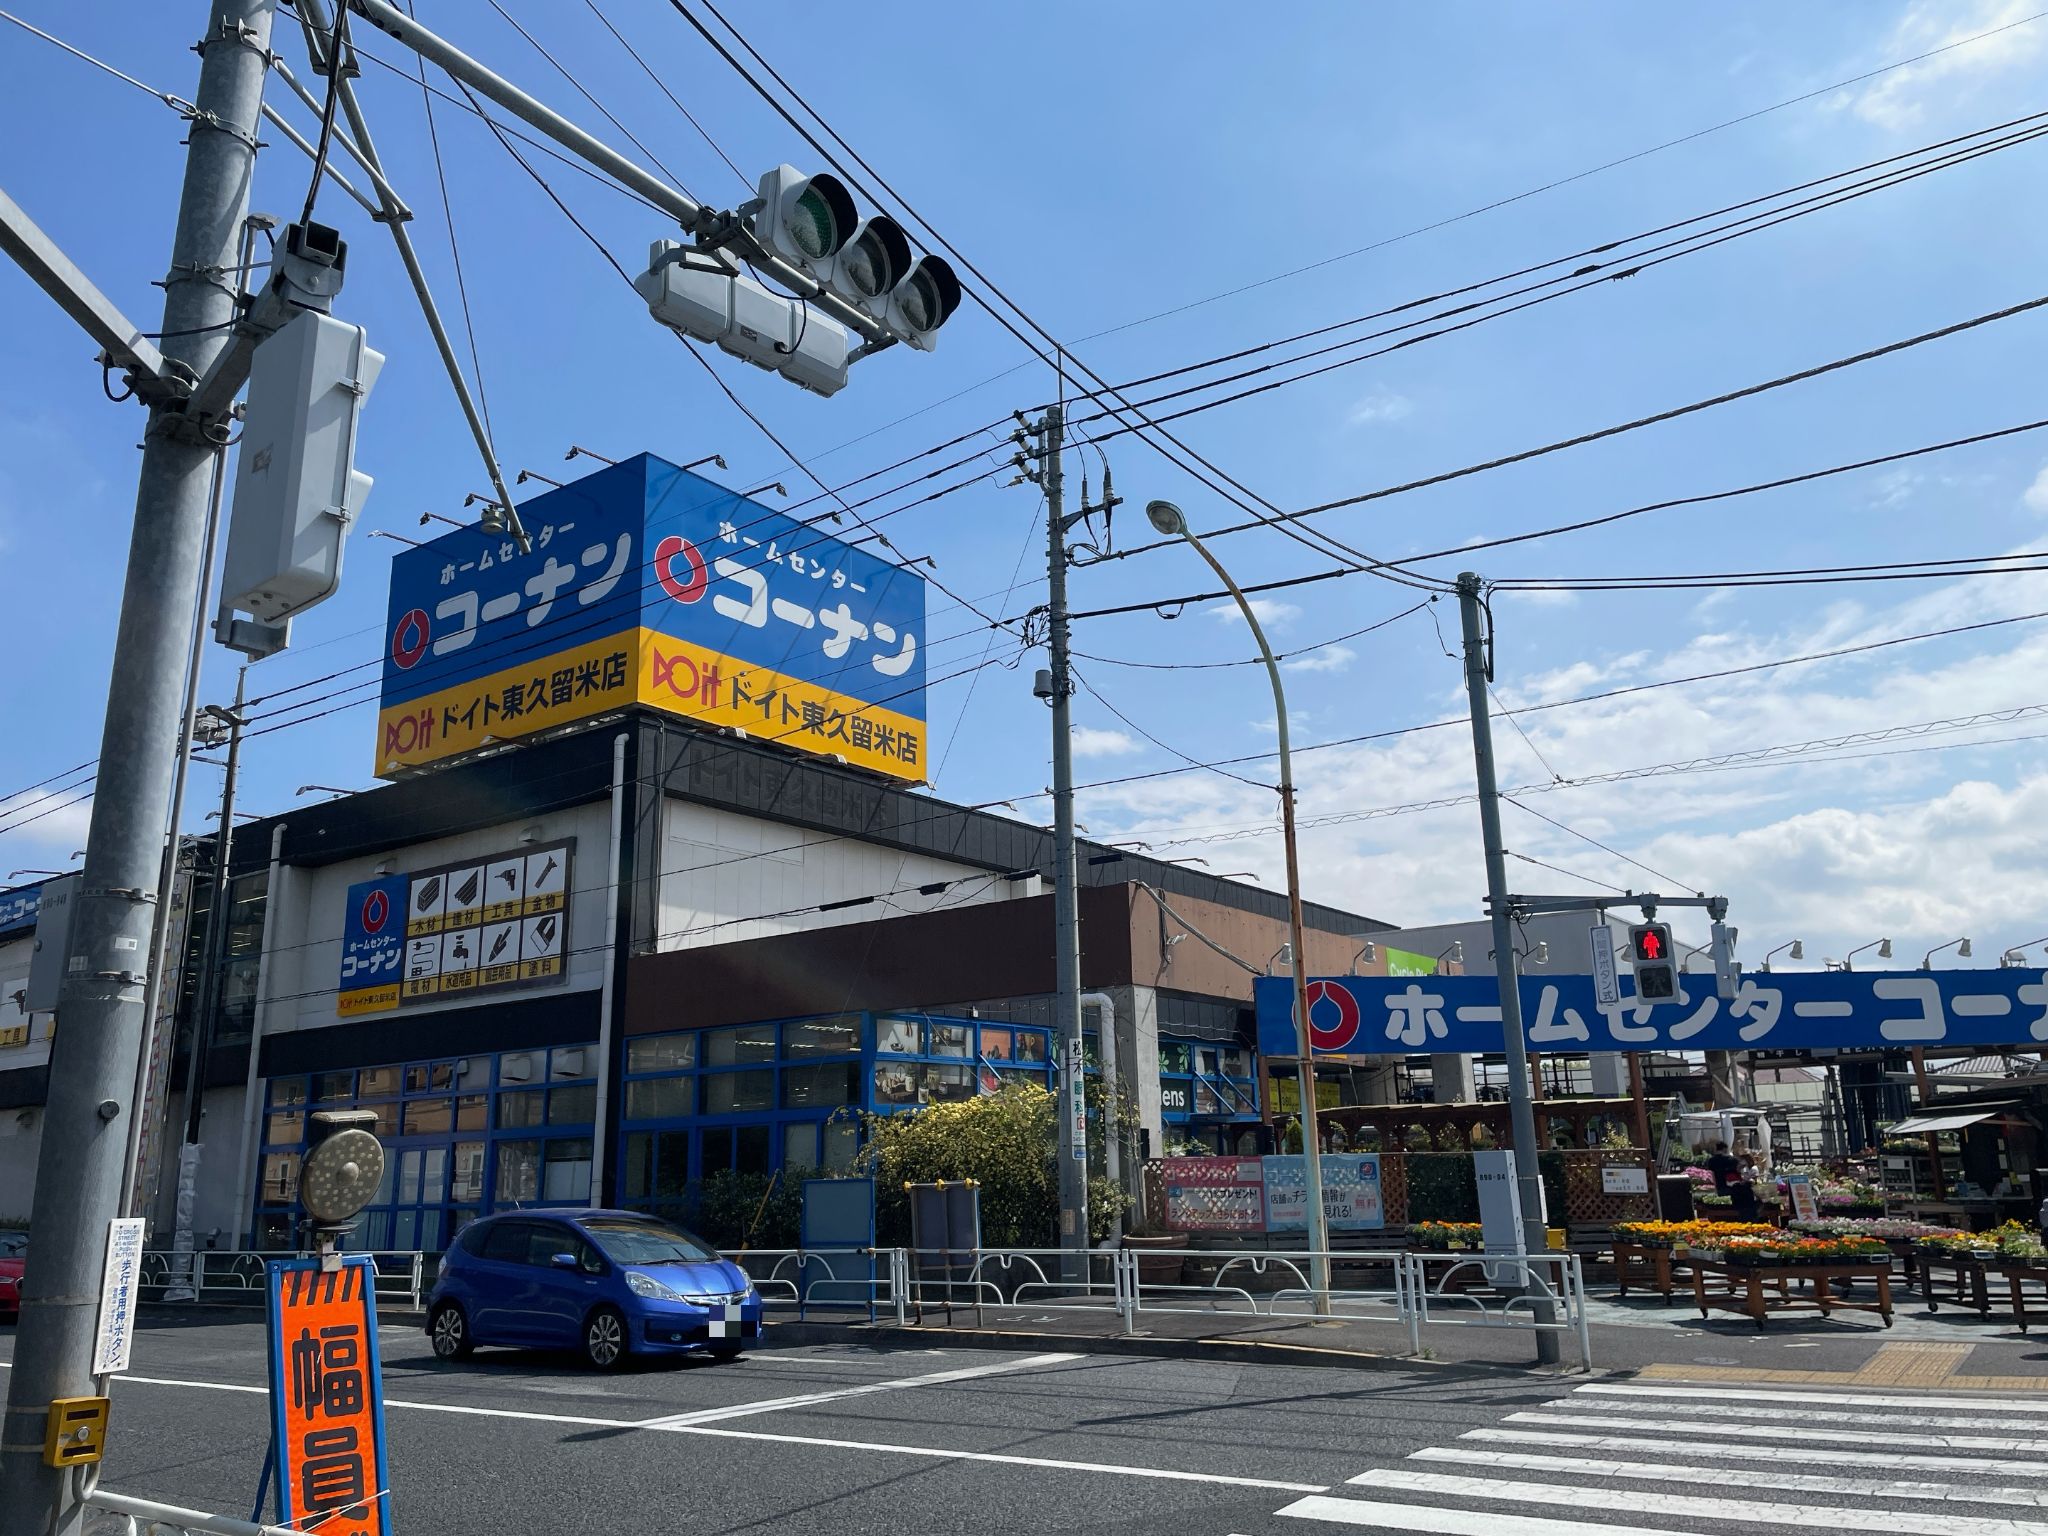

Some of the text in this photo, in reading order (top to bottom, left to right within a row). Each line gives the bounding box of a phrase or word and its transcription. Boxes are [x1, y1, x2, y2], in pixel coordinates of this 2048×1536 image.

[718, 521, 867, 593] ホームセンター
[432, 532, 632, 656] コーナン
[712, 556, 916, 677] コーナン
[442, 652, 628, 739] ドイト東久留米店
[732, 676, 918, 766] ドイト東久留米店
[350, 935, 397, 952] ホームセンター
[415, 917, 436, 931] 木材
[491, 901, 514, 918] 工具
[342, 948, 401, 977] コーナン
[1384, 980, 1853, 1046] ホームセンター
[1271, 1189, 1346, 1205] 店舗のチラ情報が
[110, 1258, 132, 1364] 歩行者用押ボタン
[292, 1324, 370, 1536] 幅員
